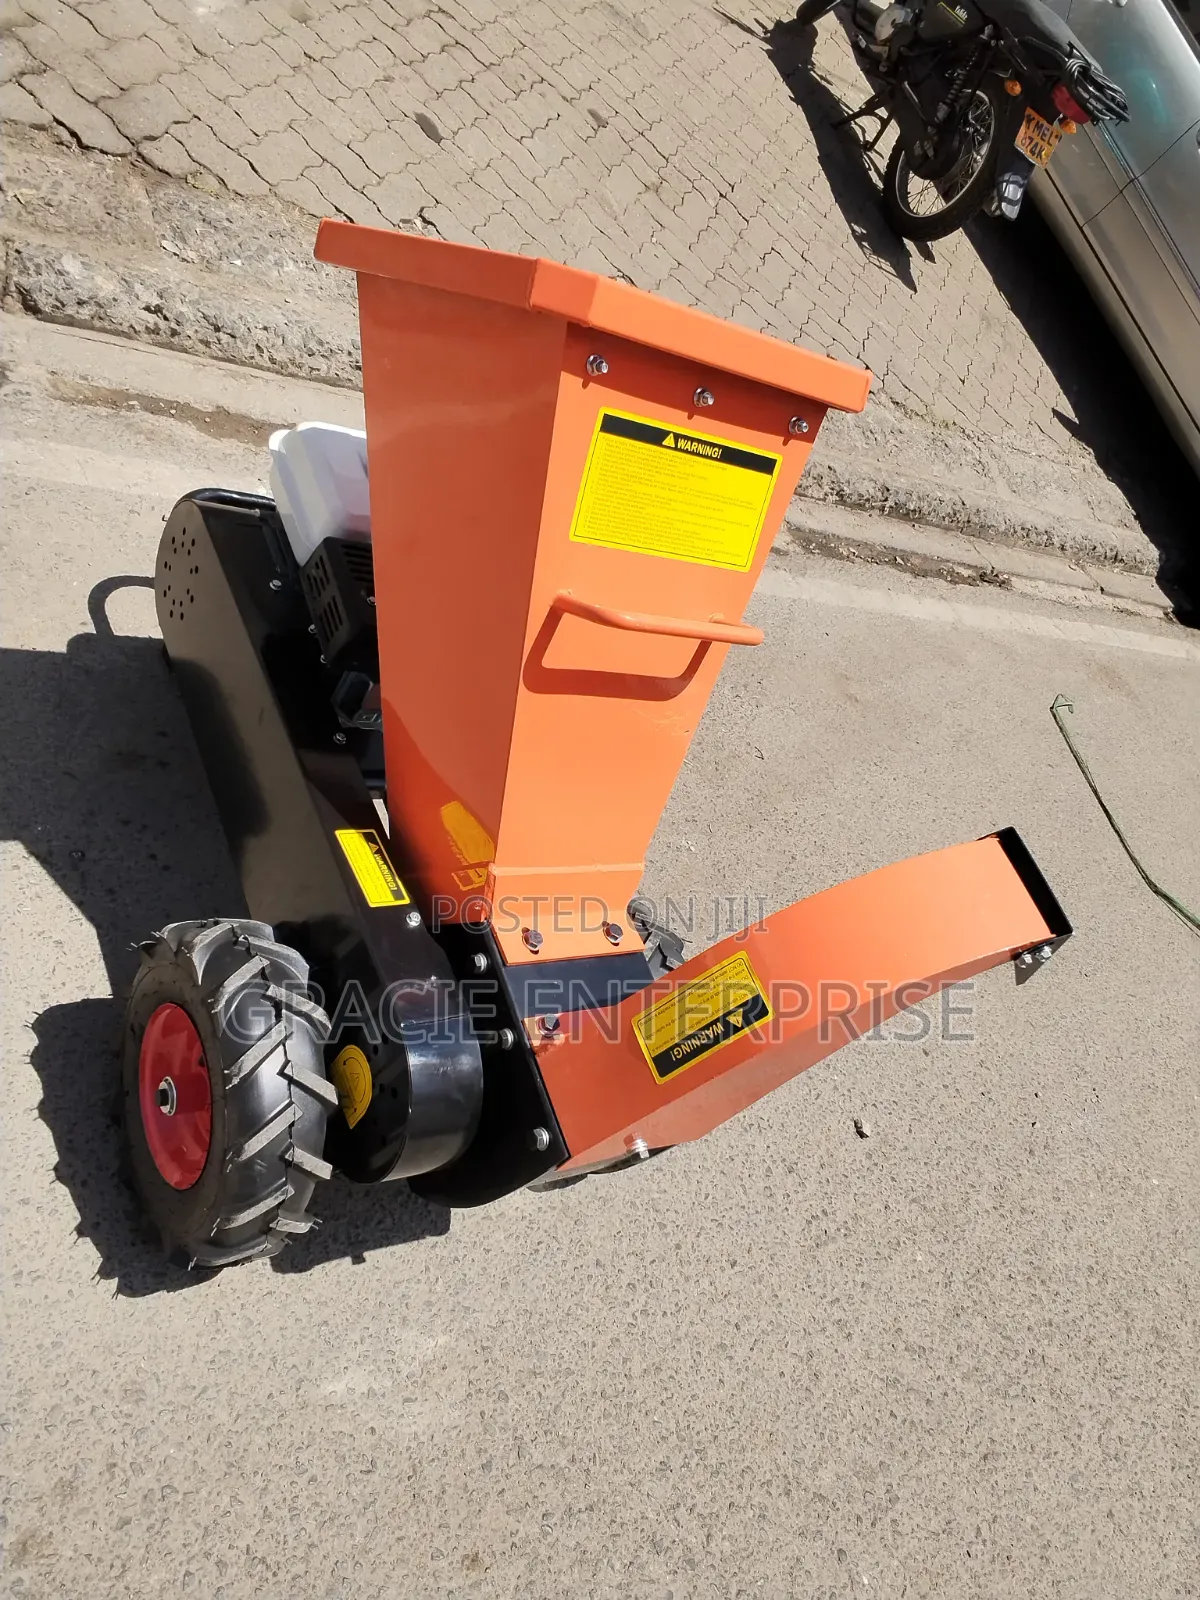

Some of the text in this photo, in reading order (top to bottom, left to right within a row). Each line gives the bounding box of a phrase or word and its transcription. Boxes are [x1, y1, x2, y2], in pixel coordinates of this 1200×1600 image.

[677, 438, 722, 459] WARNING!
[374, 853, 398, 891] WARNING!
[671, 1022, 725, 1062] WARNING!
